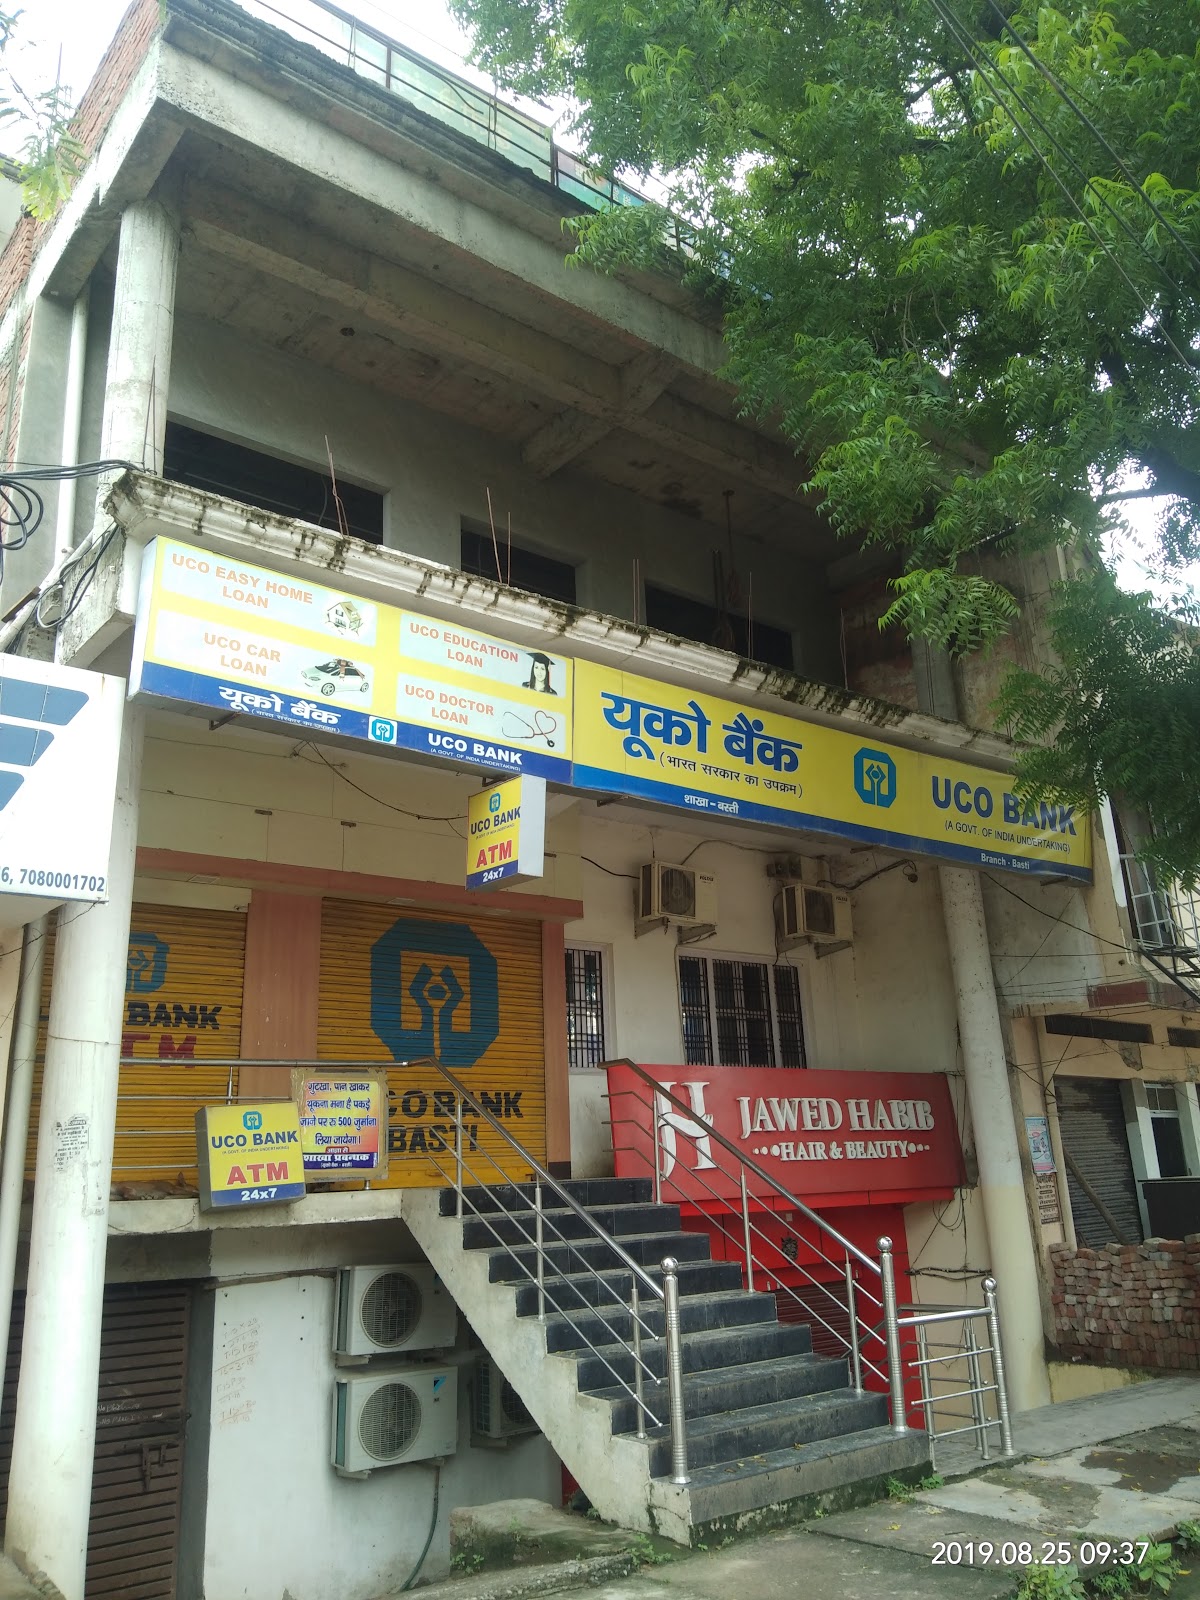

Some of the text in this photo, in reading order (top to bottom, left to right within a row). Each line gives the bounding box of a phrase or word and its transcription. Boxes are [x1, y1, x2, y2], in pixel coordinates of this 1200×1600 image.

[172, 553, 313, 604] UCO EASY HOME
[222, 585, 269, 608] LOAN
[203, 632, 281, 662] UCO CAR
[410, 622, 518, 662] UCO EDUCATION
[220, 654, 267, 677] LOAN
[447, 648, 483, 668] LOAN
[218, 686, 341, 725] यूको बैंक
[405, 684, 494, 716] UCO DOCTOR
[431, 707, 468, 725] LOAN
[601, 691, 803, 773] यूको बैंक
[428, 732, 522, 765] UCO BANK
[660, 751, 803, 799] (भारत सरकार का उपक्रम)
[684, 794, 709, 808] शाखा
[931, 775, 1077, 836] UCO BANK
[470, 817, 491, 835] UCO
[493, 806, 521, 828] BANK
[944, 819, 1071, 854] (A GOVT. OF INDIA UNDERTAKING)
[476, 840, 512, 869] ATM
[981, 853, 1006, 866] Branch
[1012, 858, 1030, 870] Basti
[20, 868, 105, 892] 7080001702
[482, 866, 504, 883] 24x7
[125, 1001, 222, 1030] BANK
[338, 1116, 352, 1126] 500
[736, 1096, 935, 1140] JAWED HABIB
[211, 1130, 299, 1149] UCO BANK
[388, 1124, 478, 1153] BASTI
[780, 1140, 909, 1162] HAIR & BEAUTY
[226, 1161, 289, 1186] ATM
[241, 1187, 278, 1201] 24x7
